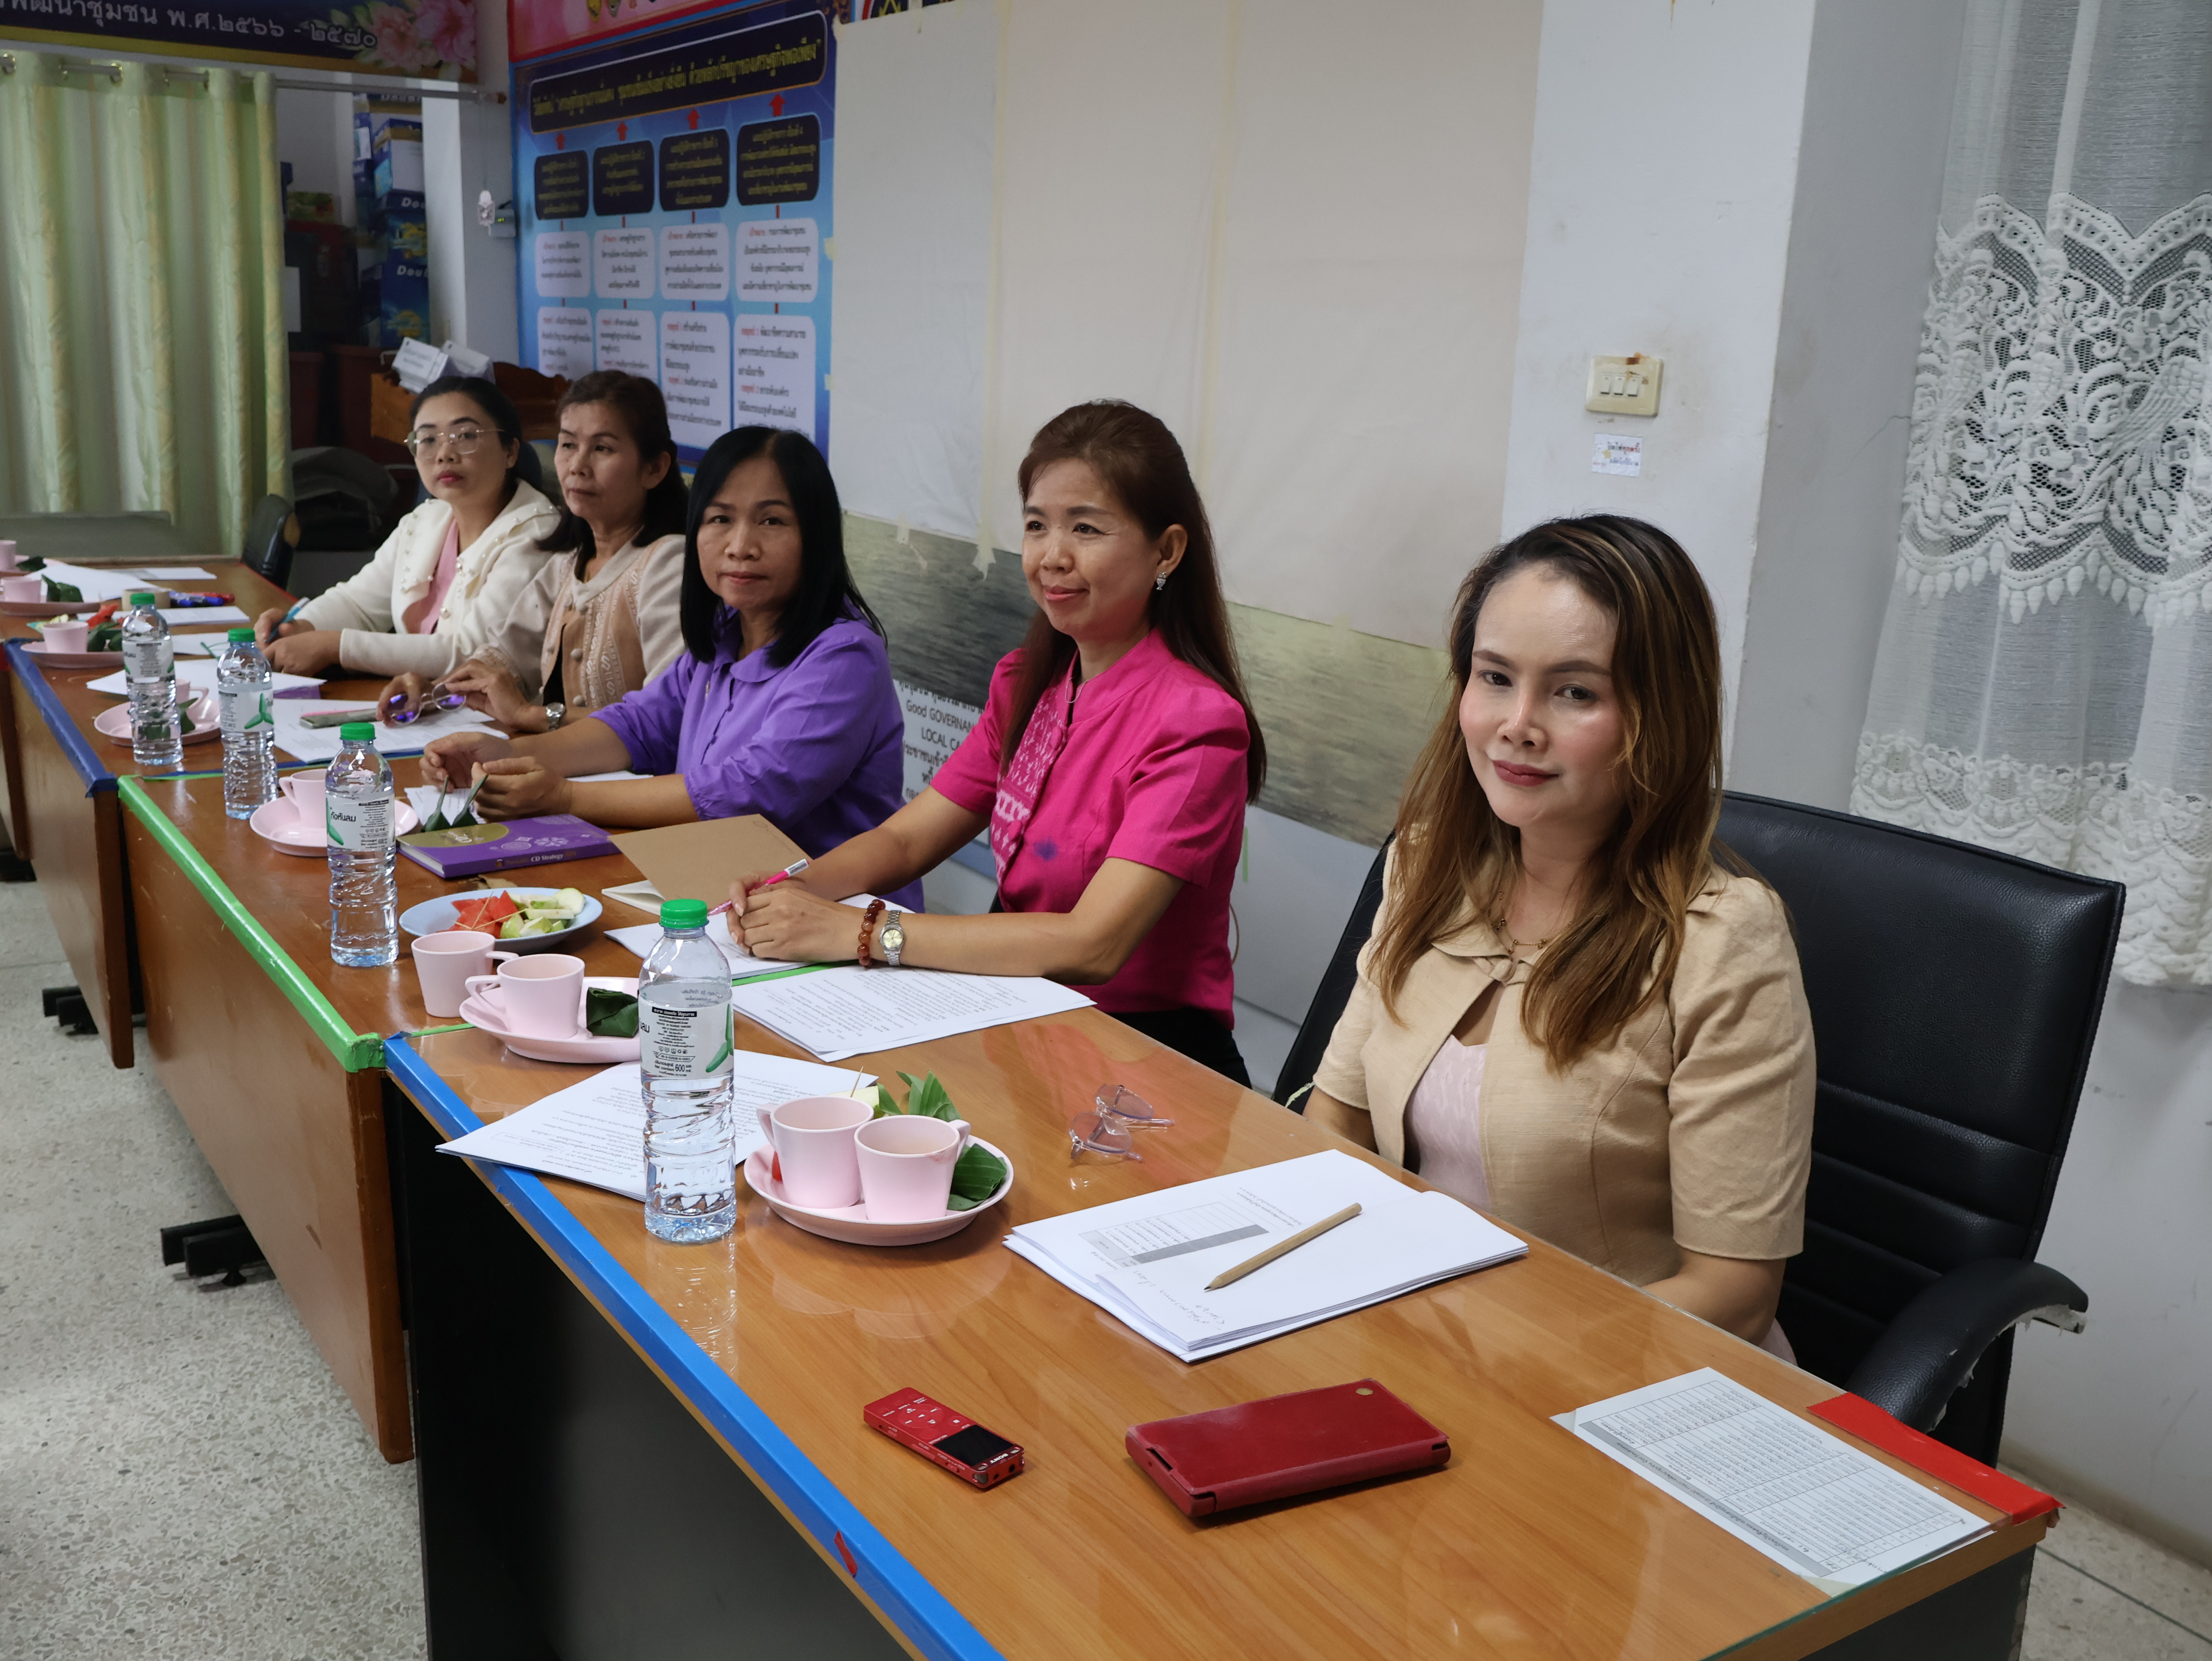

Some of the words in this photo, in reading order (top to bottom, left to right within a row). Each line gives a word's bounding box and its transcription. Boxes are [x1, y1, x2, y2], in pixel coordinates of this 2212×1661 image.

[906, 700, 927, 718] Good
[921, 727, 947, 748] LOCAL
[989, 1453, 1009, 1464] SONY
